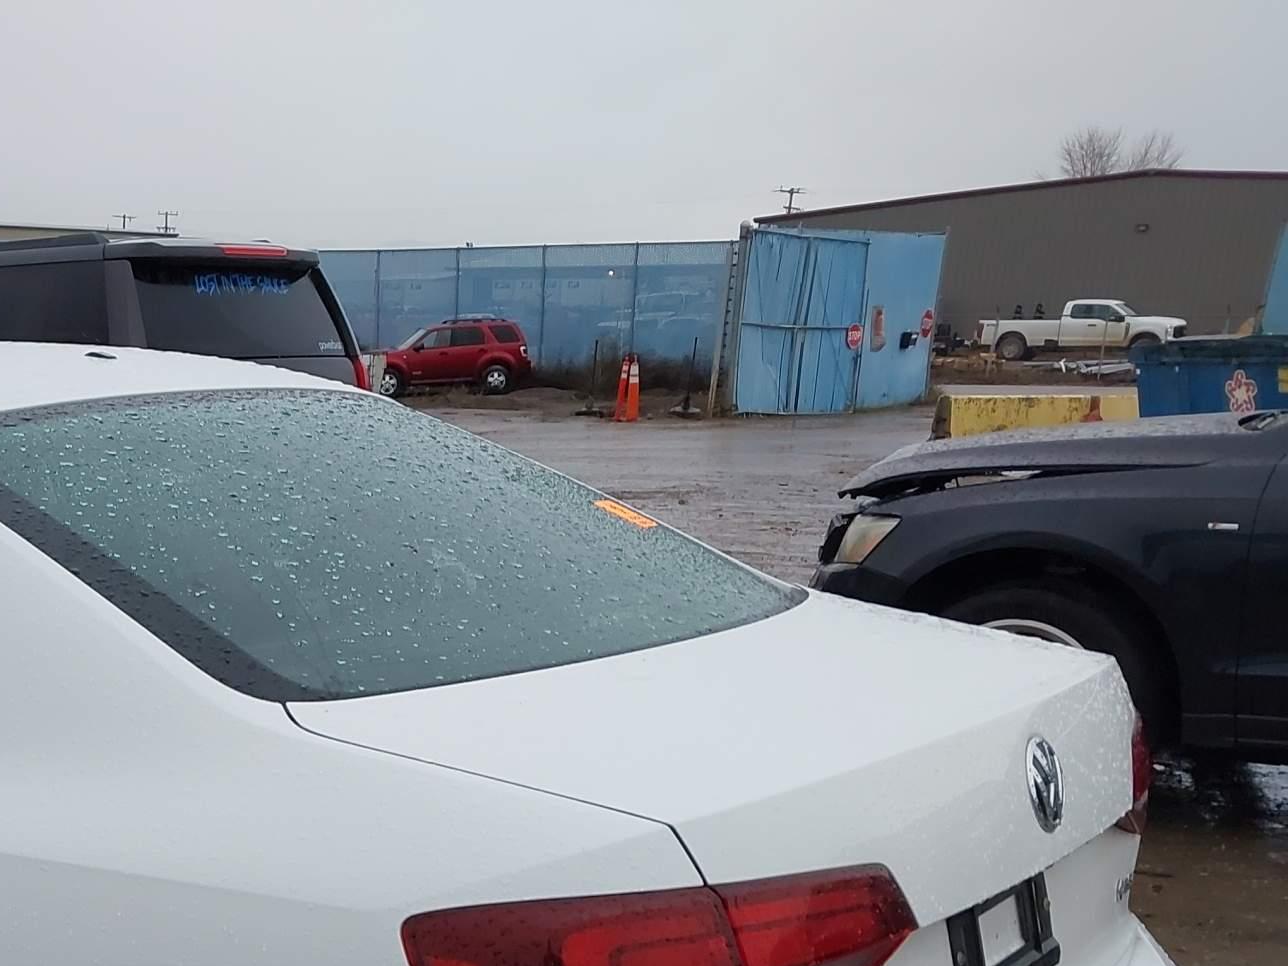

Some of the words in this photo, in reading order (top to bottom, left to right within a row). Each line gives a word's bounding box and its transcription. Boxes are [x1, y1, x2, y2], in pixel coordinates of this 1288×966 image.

[194, 273, 221, 296] LOST
[221, 274, 236, 293] IN
[231, 274, 257, 293] THE
[848, 330, 861, 340] STOP
